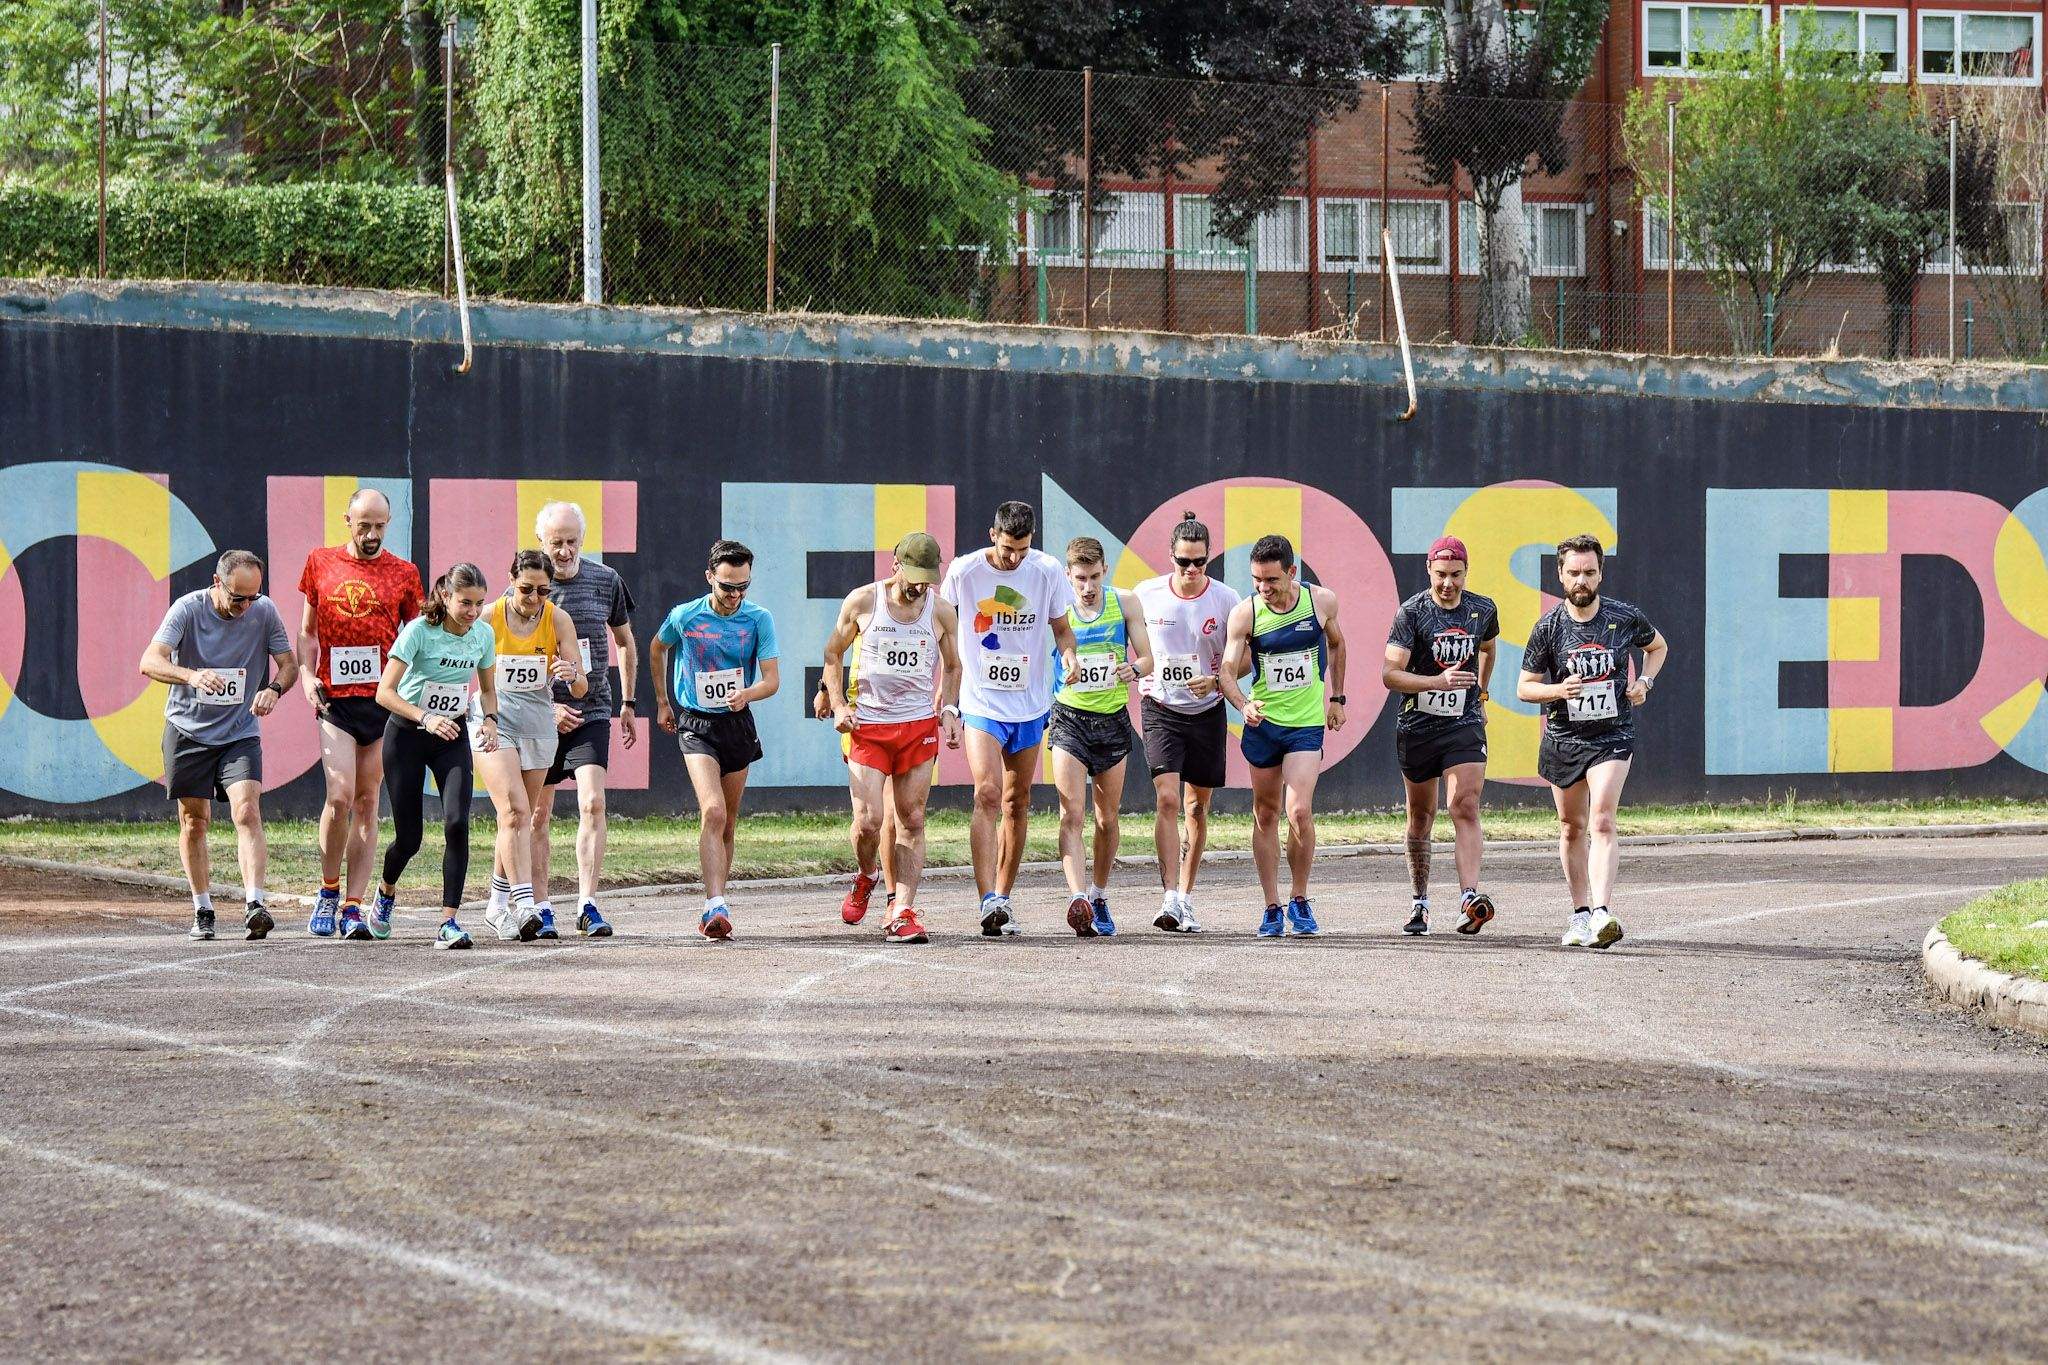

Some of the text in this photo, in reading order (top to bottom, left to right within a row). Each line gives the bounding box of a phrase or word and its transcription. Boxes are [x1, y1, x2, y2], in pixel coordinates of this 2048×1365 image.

[996, 611, 1036, 625] Ibiza
[886, 650, 918, 667] 803
[339, 660, 372, 676] 908
[505, 668, 538, 683] 759
[988, 665, 1021, 682] 869
[1080, 665, 1109, 683] 867
[1162, 666, 1193, 682] 866
[1273, 665, 1306, 683] 764
[704, 681, 737, 699] 905
[427, 694, 460, 712] 882
[1427, 691, 1458, 708] 719
[1578, 693, 1607, 712] 717
